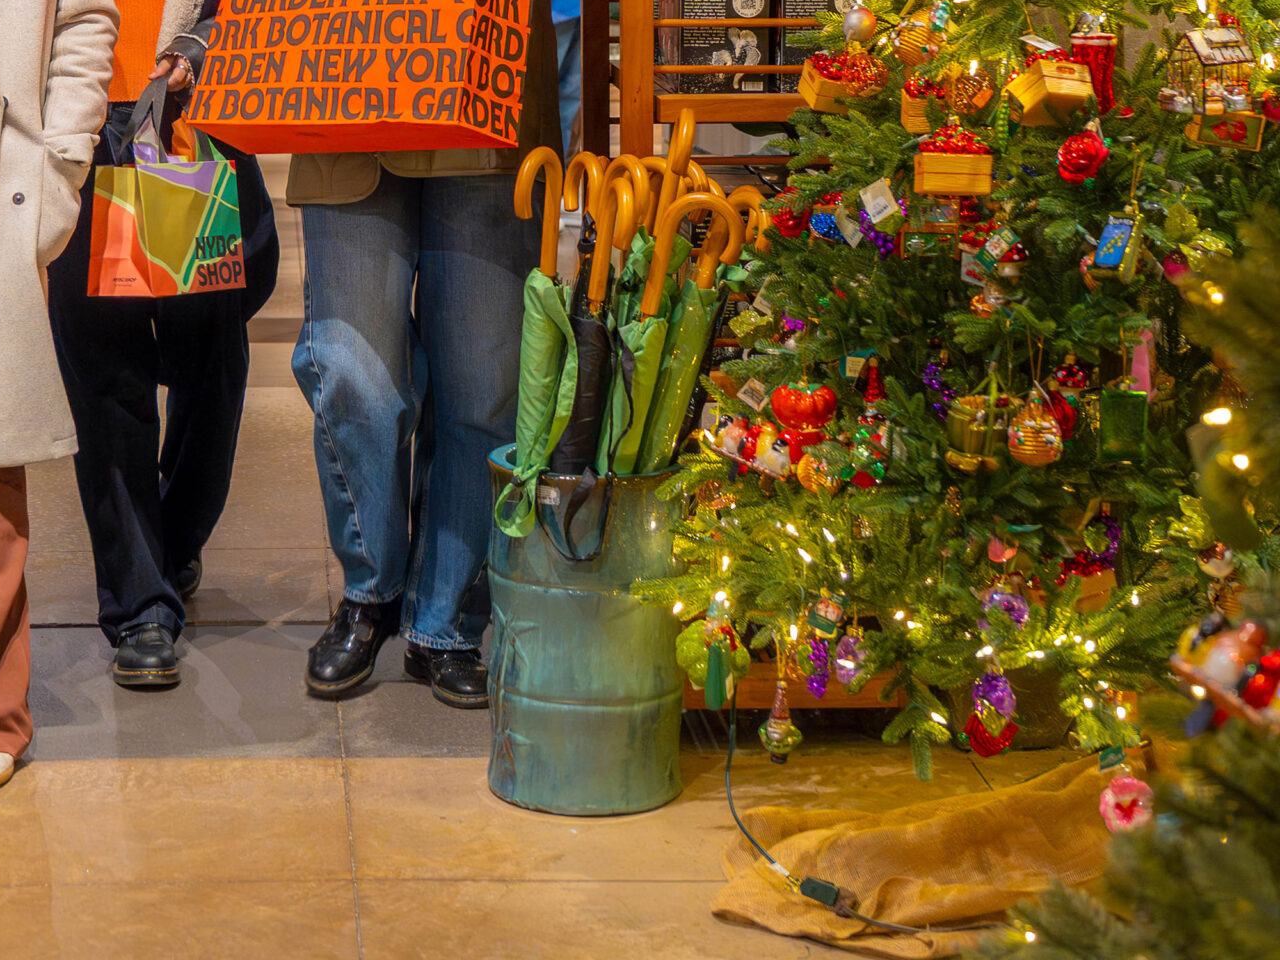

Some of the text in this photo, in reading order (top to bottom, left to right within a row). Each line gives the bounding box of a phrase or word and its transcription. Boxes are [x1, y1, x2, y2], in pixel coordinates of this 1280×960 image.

[265, 9, 448, 49] BOTANICAL
[296, 48, 377, 83] NEW
[385, 48, 476, 85] YORK
[191, 87, 520, 143] K BOTANICAL GARDEN
[195, 234, 239, 260] NYBG
[197, 261, 242, 286] SHOP
